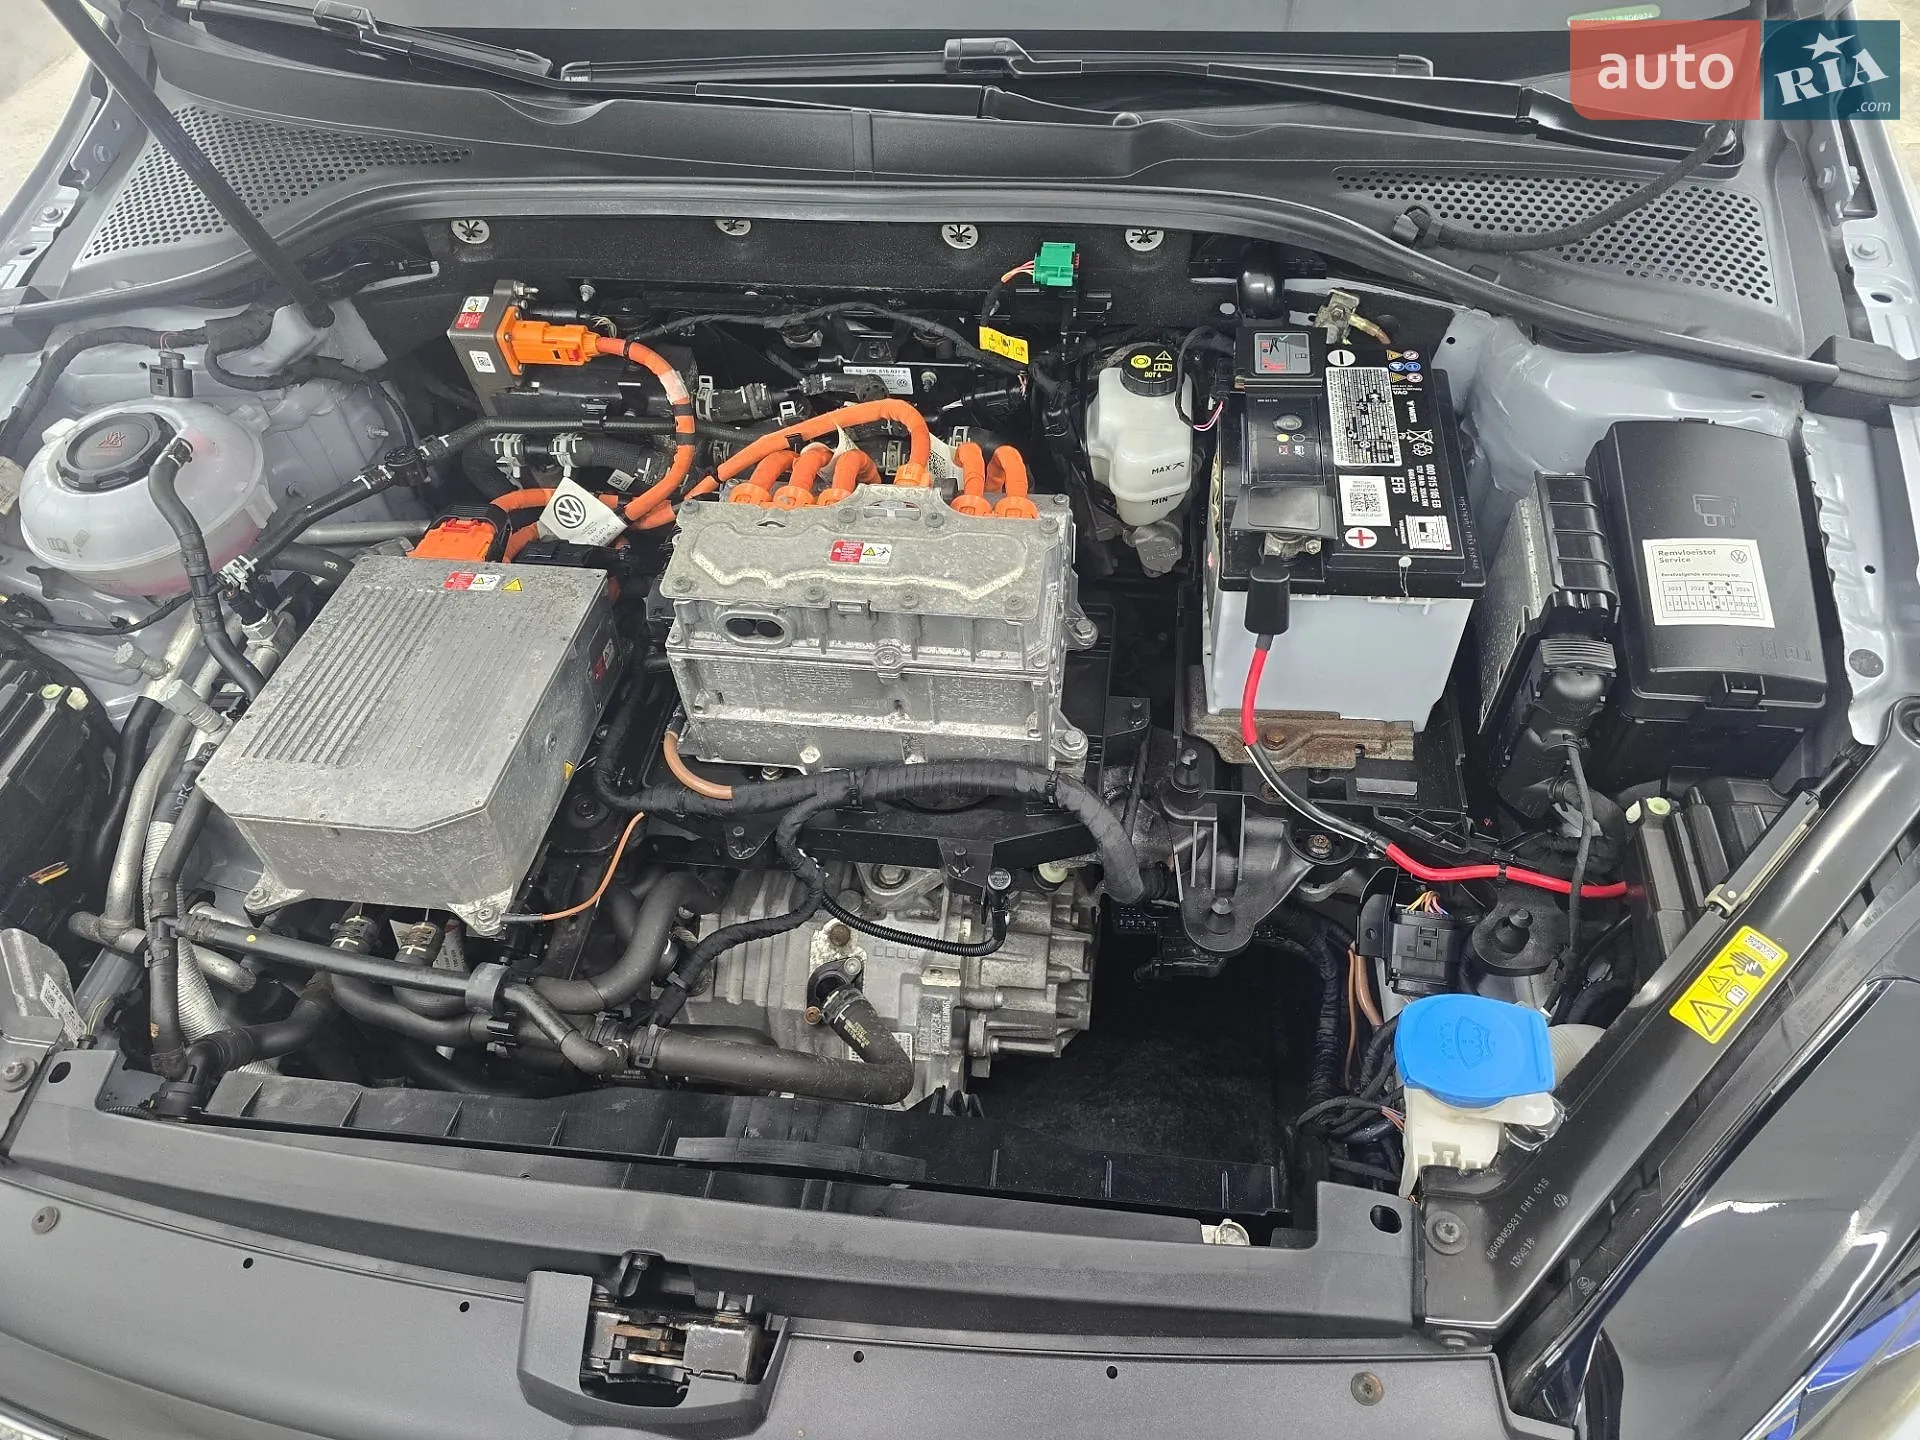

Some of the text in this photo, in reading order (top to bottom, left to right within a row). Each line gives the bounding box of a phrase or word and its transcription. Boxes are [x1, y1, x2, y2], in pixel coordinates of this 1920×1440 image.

[1151, 465, 1172, 475] MAX
[1390, 476, 1407, 494] EFB
[1151, 497, 1168, 506] MIN
